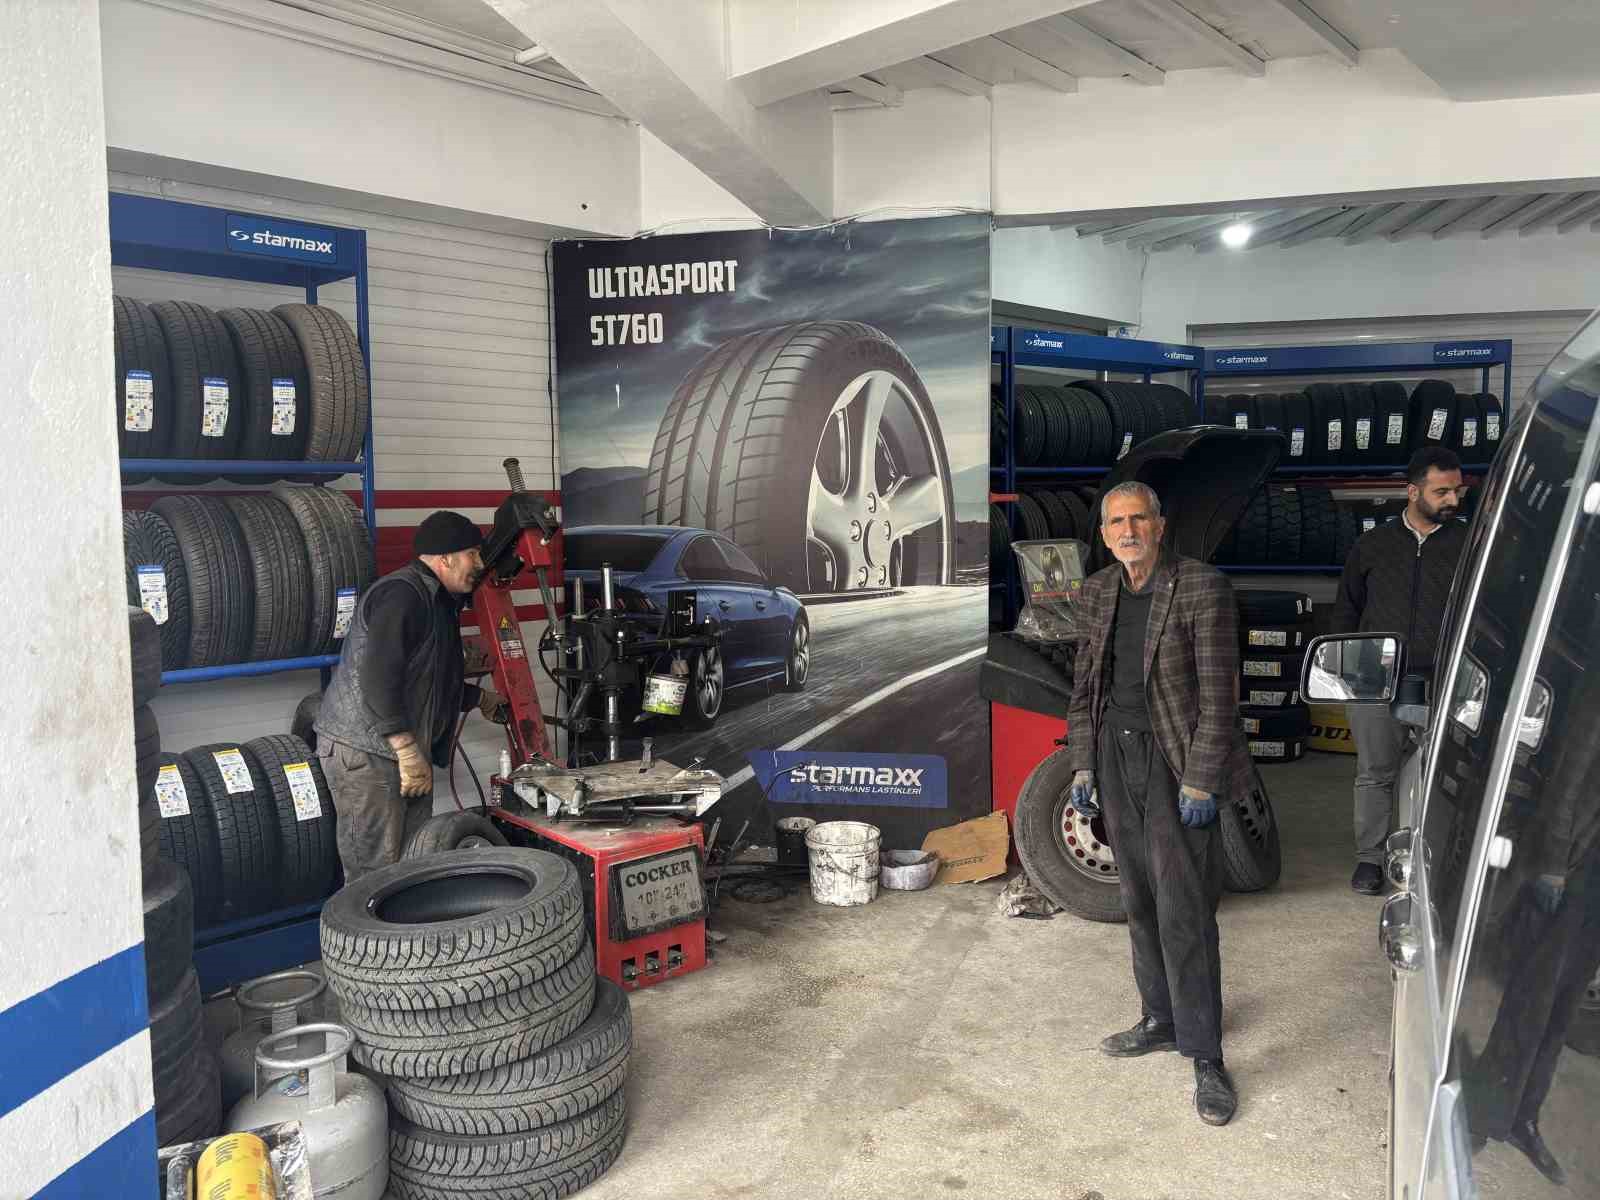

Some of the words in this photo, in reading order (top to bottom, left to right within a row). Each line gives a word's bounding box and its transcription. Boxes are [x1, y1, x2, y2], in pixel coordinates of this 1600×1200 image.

[251, 229, 334, 255] starmaxx
[587, 259, 739, 299] ULTRASPORT
[589, 312, 665, 347] ST760
[1033, 338, 1065, 349] starmaxx
[1446, 346, 1493, 358] starmaxx
[1226, 354, 1268, 365] starmaxx
[790, 763, 924, 787] starmaxx
[625, 859, 693, 888] COCKER
